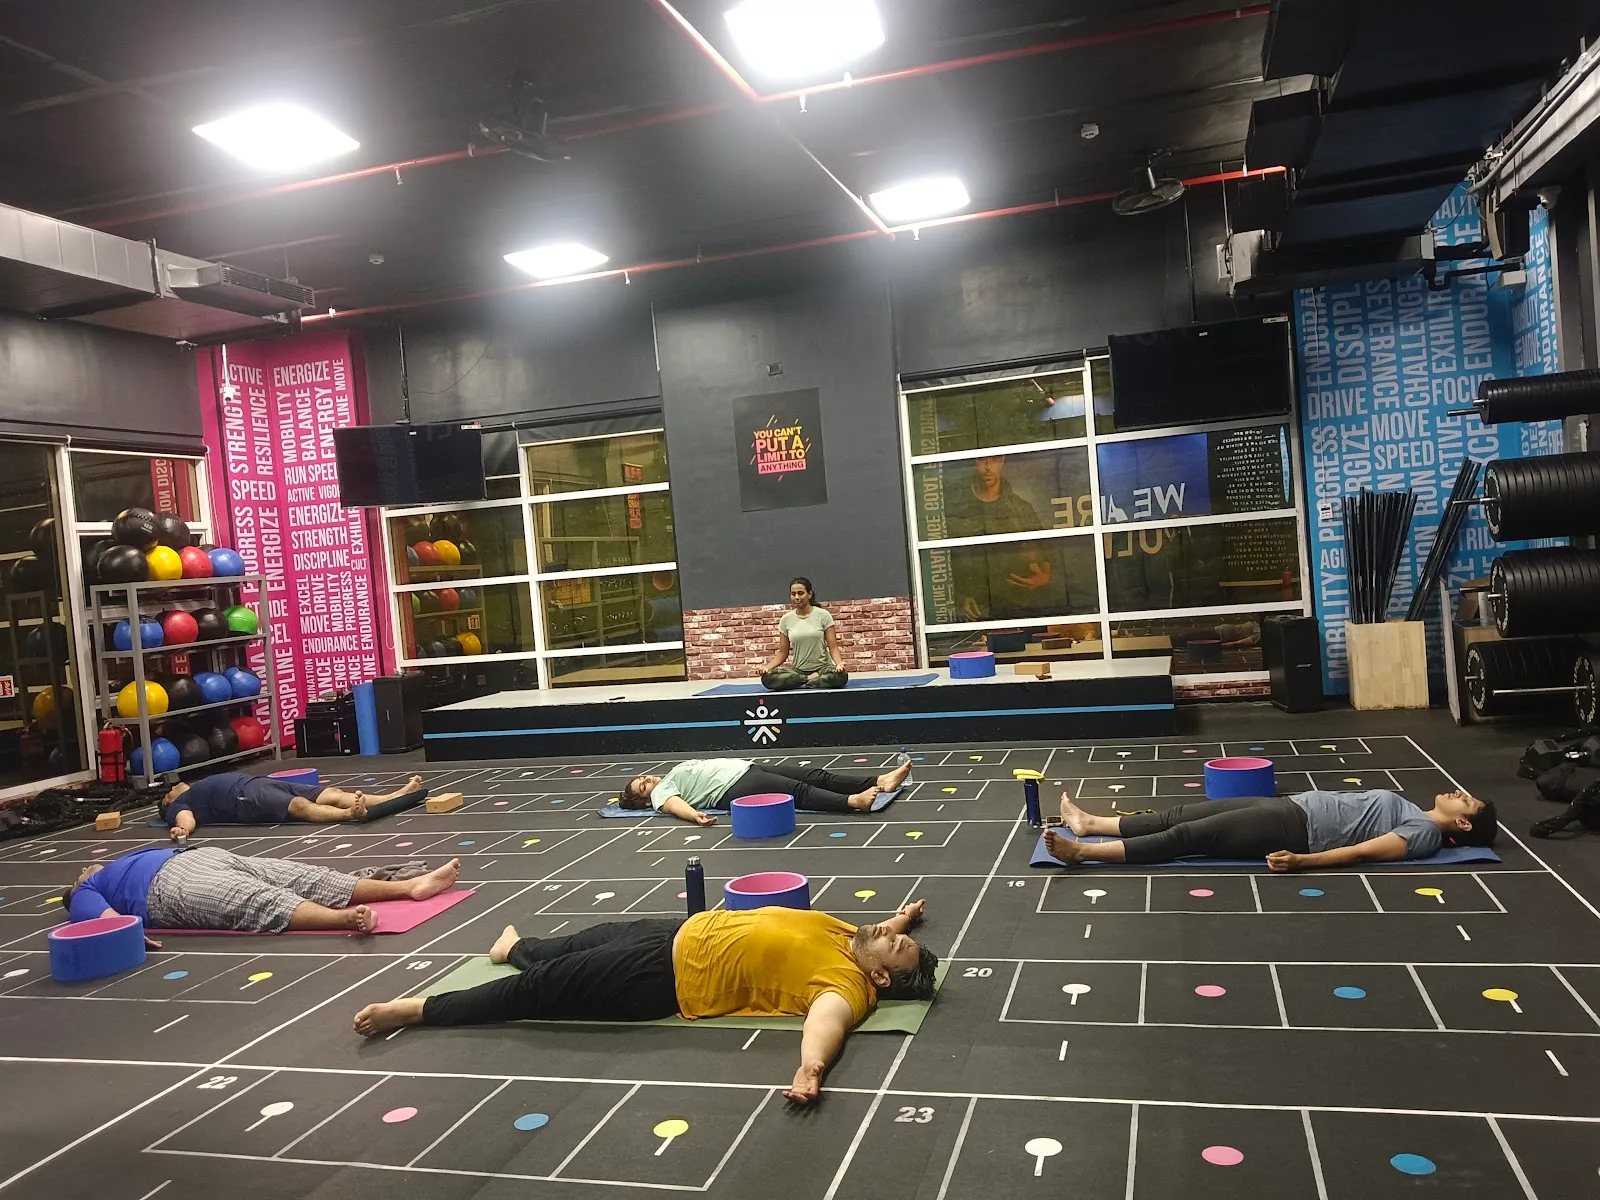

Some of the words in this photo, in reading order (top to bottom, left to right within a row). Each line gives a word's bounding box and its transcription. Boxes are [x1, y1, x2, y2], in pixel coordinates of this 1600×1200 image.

[1396, 274, 1430, 408] CHALLENGE
[273, 360, 331, 388] ENERGIZE
[332, 358, 347, 391] MOVE
[1306, 386, 1369, 420] DRIVE
[249, 387, 274, 476] RESILIENCE
[276, 391, 298, 464] MOBILITY
[295, 387, 317, 462] BALANCE
[753, 430, 773, 440] YOU
[774, 426, 803, 437] CAN'T
[1371, 409, 1431, 442] MOVE
[755, 437, 789, 453] PUT
[792, 435, 804, 450] A
[757, 451, 788, 463] LIMIT
[789, 449, 805, 459] TO
[1373, 439, 1435, 470] SPEED
[284, 466, 307, 486] RUN
[760, 460, 804, 473] ANYTHING
[232, 480, 276, 501] SPEED
[287, 487, 315, 503] ACTIVE
[288, 502, 346, 527] ENERGIZE
[258, 506, 286, 592] ENERGIZE
[290, 527, 348, 550] STRENGTH
[293, 549, 351, 572] DISCIPLINE
[351, 558, 368, 571] CULT
[296, 574, 312, 615] EXCEL
[311, 573, 327, 613] DRIVE
[326, 573, 345, 632] MOBILITY
[340, 571, 357, 631] PROGRESS
[300, 614, 332, 635] MOVE
[355, 574, 374, 651] ENDURANCE
[1320, 568, 1351, 680] MOBILITY
[302, 634, 360, 655] ENDURANCE
[275, 646, 299, 738] DISCIPLINE
[1006, 880, 1026, 888] 16
[405, 960, 433, 970] 19
[962, 967, 993, 978] 20
[196, 1075, 239, 1089] 22
[893, 1106, 935, 1124] 23
